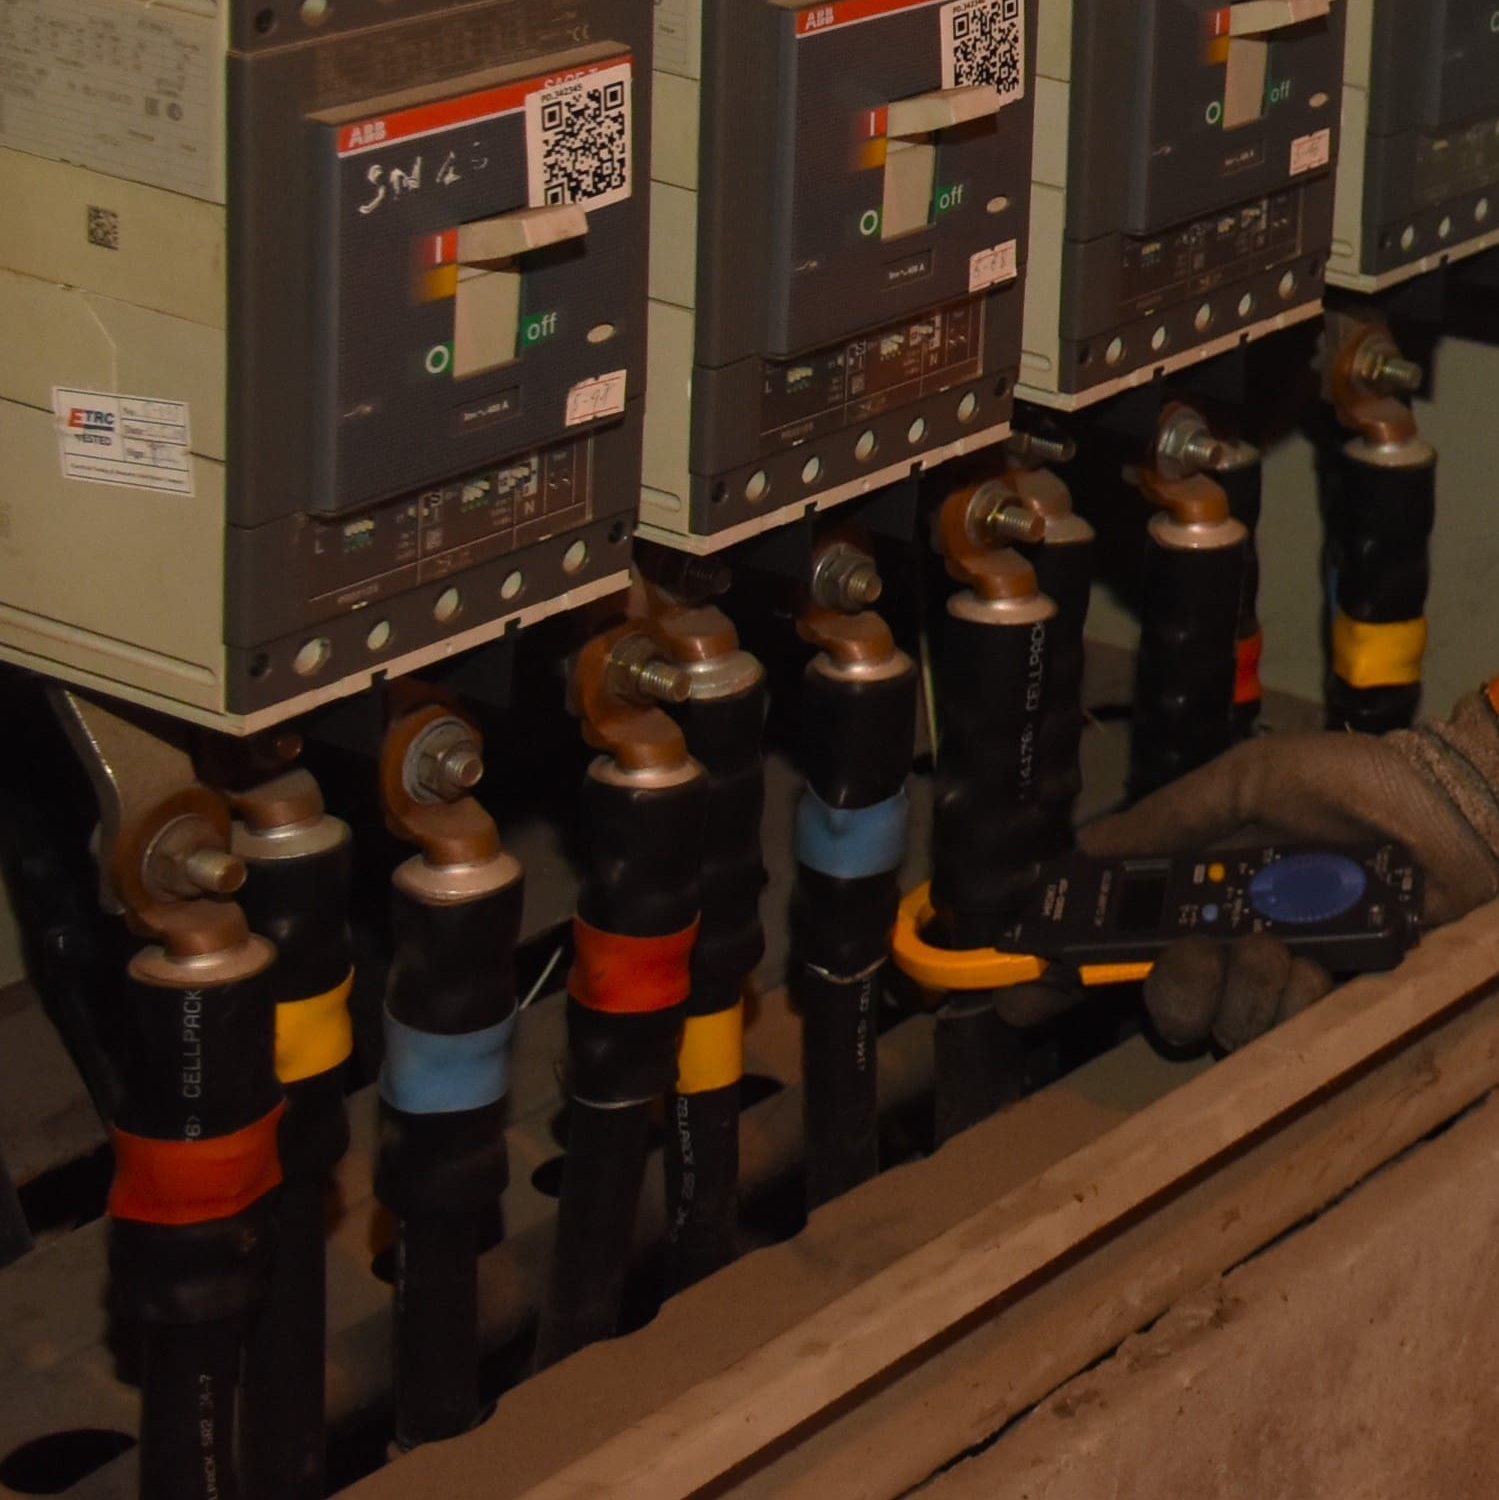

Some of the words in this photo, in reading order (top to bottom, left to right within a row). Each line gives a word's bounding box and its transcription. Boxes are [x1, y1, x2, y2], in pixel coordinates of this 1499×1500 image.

[805, 5, 835, 31] ABB
[1271, 80, 1290, 103] off
[349, 119, 387, 148] ABB
[939, 184, 965, 210] off
[527, 312, 558, 341] off
[69, 407, 115, 429] ETRC
[75, 434, 113, 447] TESTED
[183, 989, 203, 1099] CELLPACK
